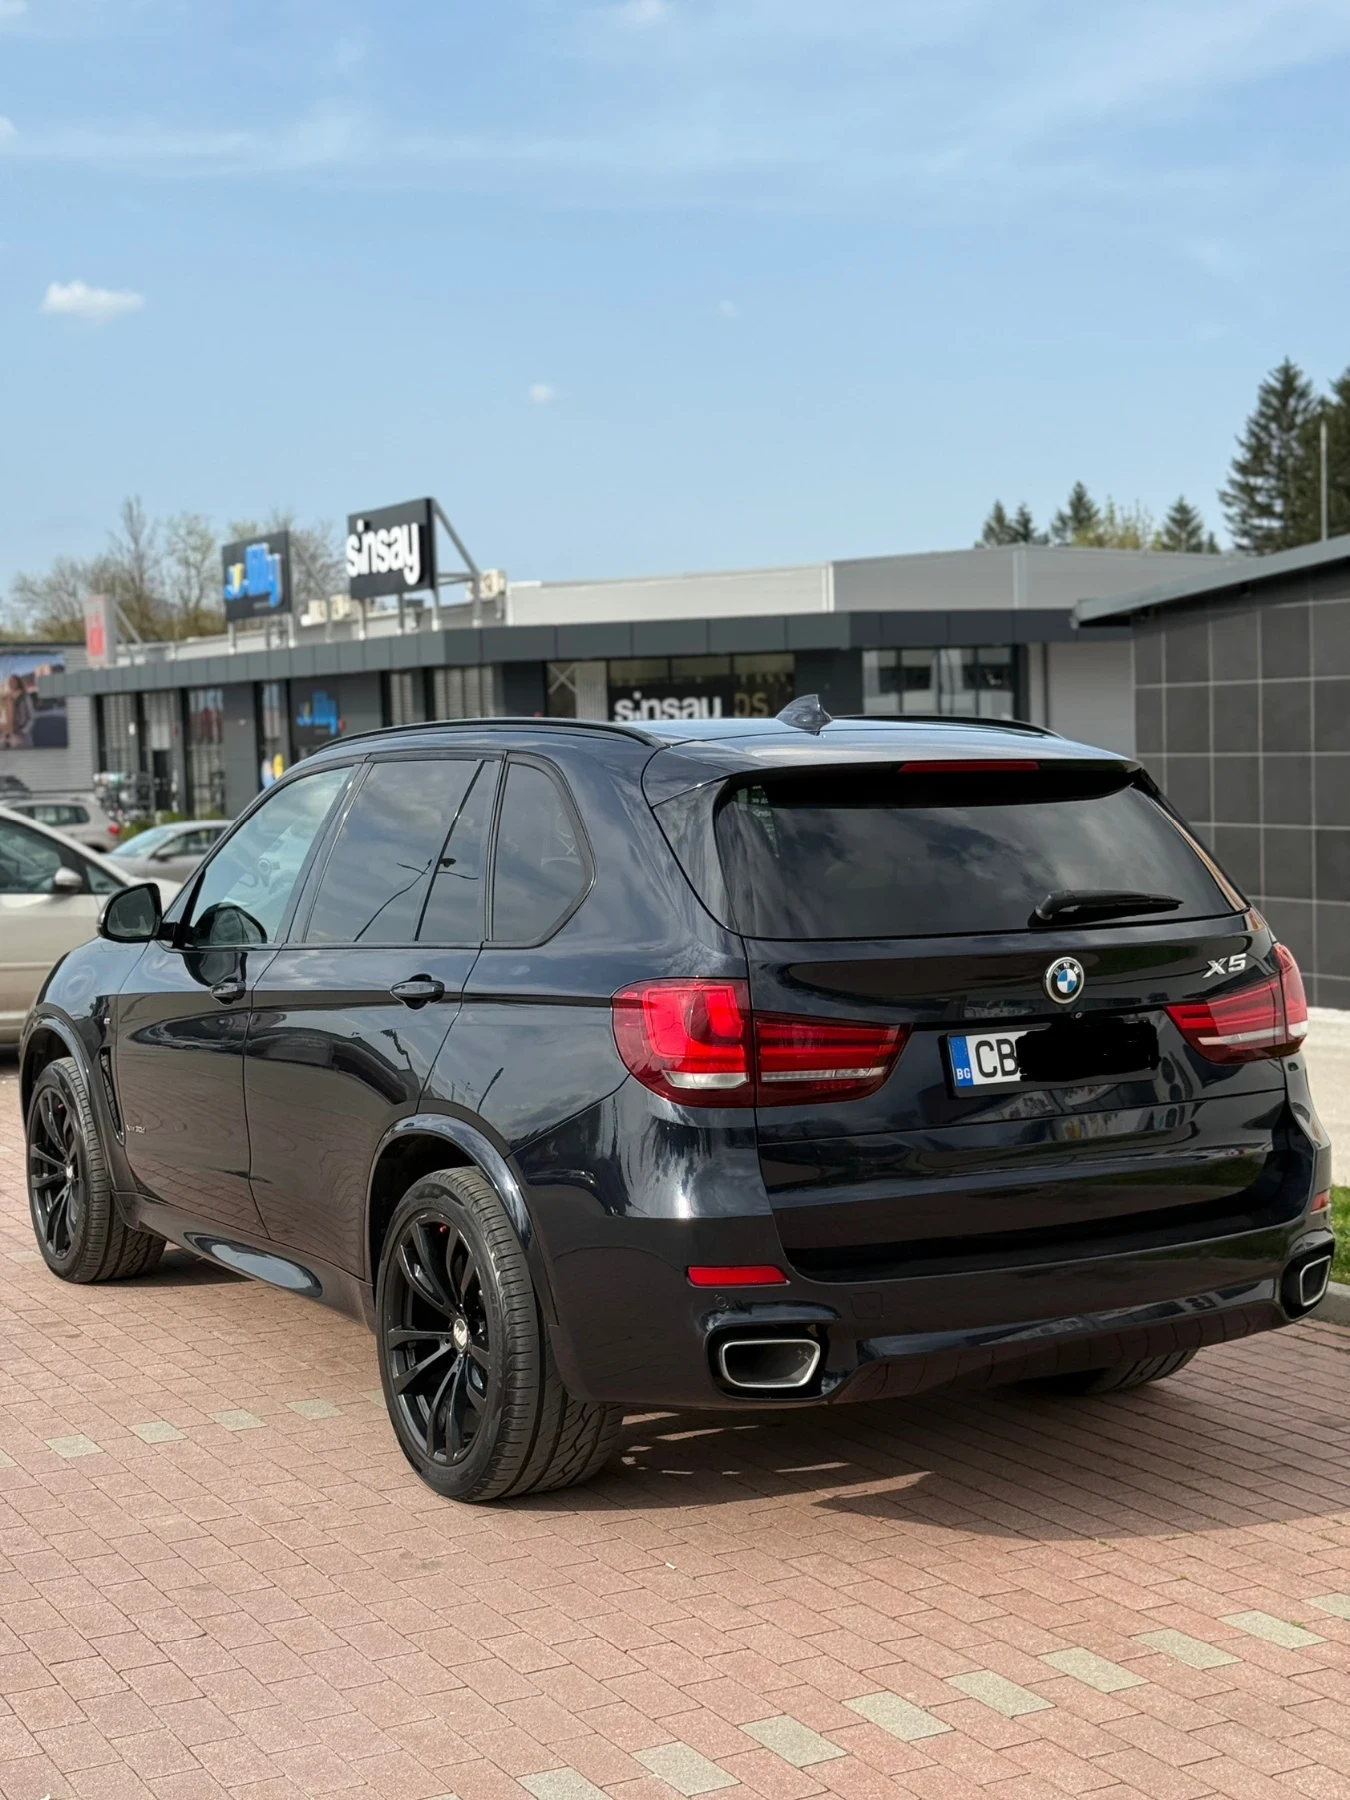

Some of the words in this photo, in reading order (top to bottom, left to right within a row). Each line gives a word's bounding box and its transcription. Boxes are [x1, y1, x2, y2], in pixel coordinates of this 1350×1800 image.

[346, 518, 421, 585] sinsay
[1053, 962, 1081, 975] BMW
[1202, 953, 1247, 979] X5
[975, 1038, 1019, 1078] CB
[956, 1068, 971, 1080] BG
